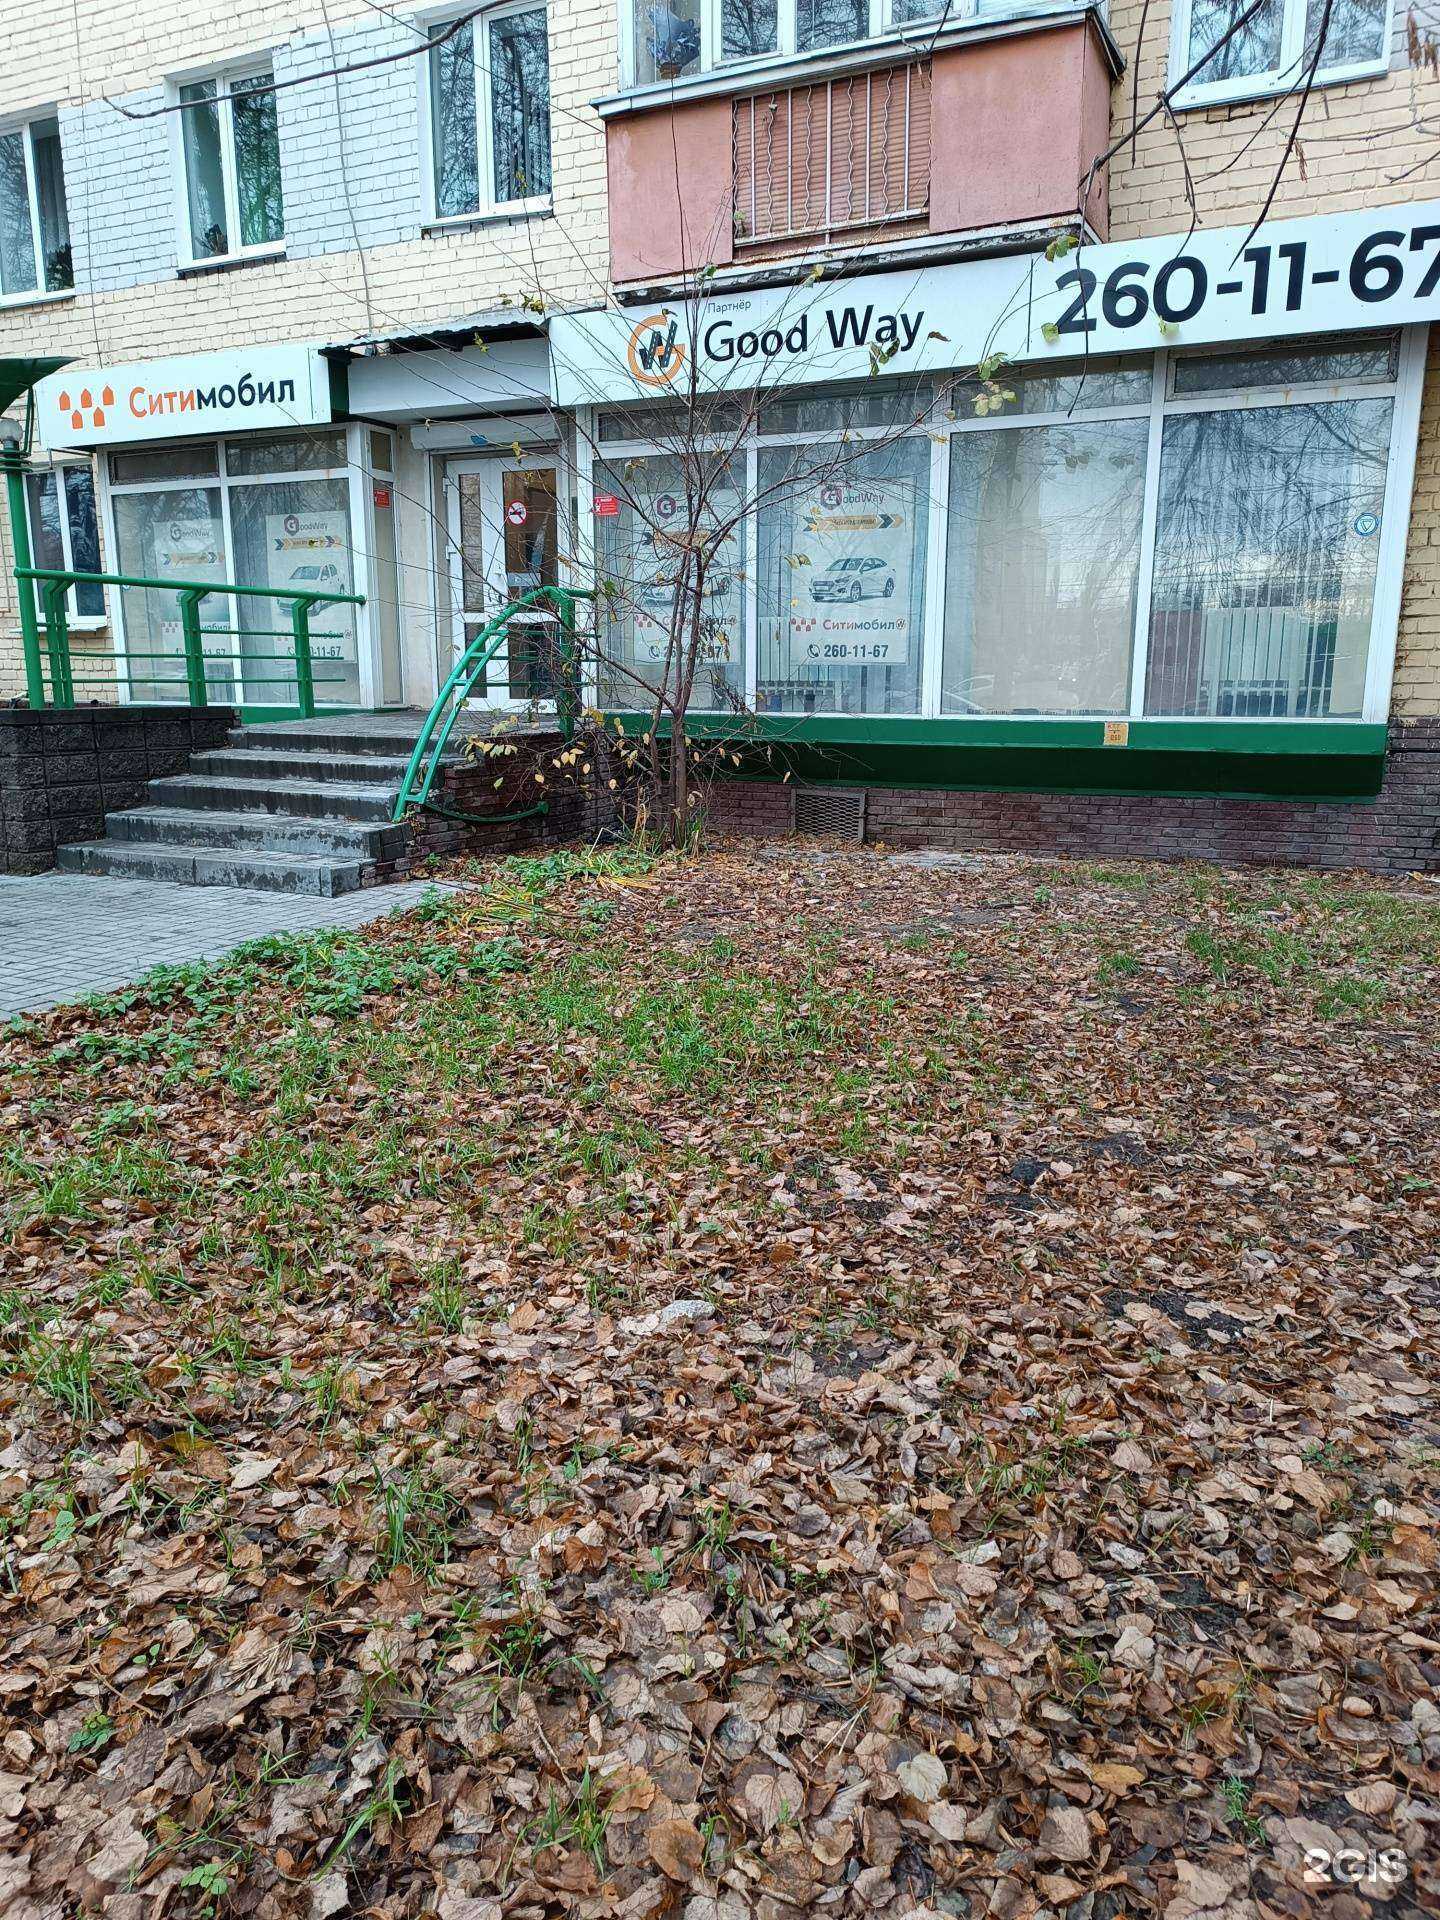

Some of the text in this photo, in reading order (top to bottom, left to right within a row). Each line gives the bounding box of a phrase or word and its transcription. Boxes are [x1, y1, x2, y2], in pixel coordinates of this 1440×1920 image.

[1054, 225, 1440, 334] 260-11-67
[707, 299, 752, 314] Партнёр
[704, 304, 925, 362] Good Way
[129, 372, 295, 418] Ситимобил
[822, 618, 895, 630] Ситимобил
[823, 644, 889, 658] 260-11-67
